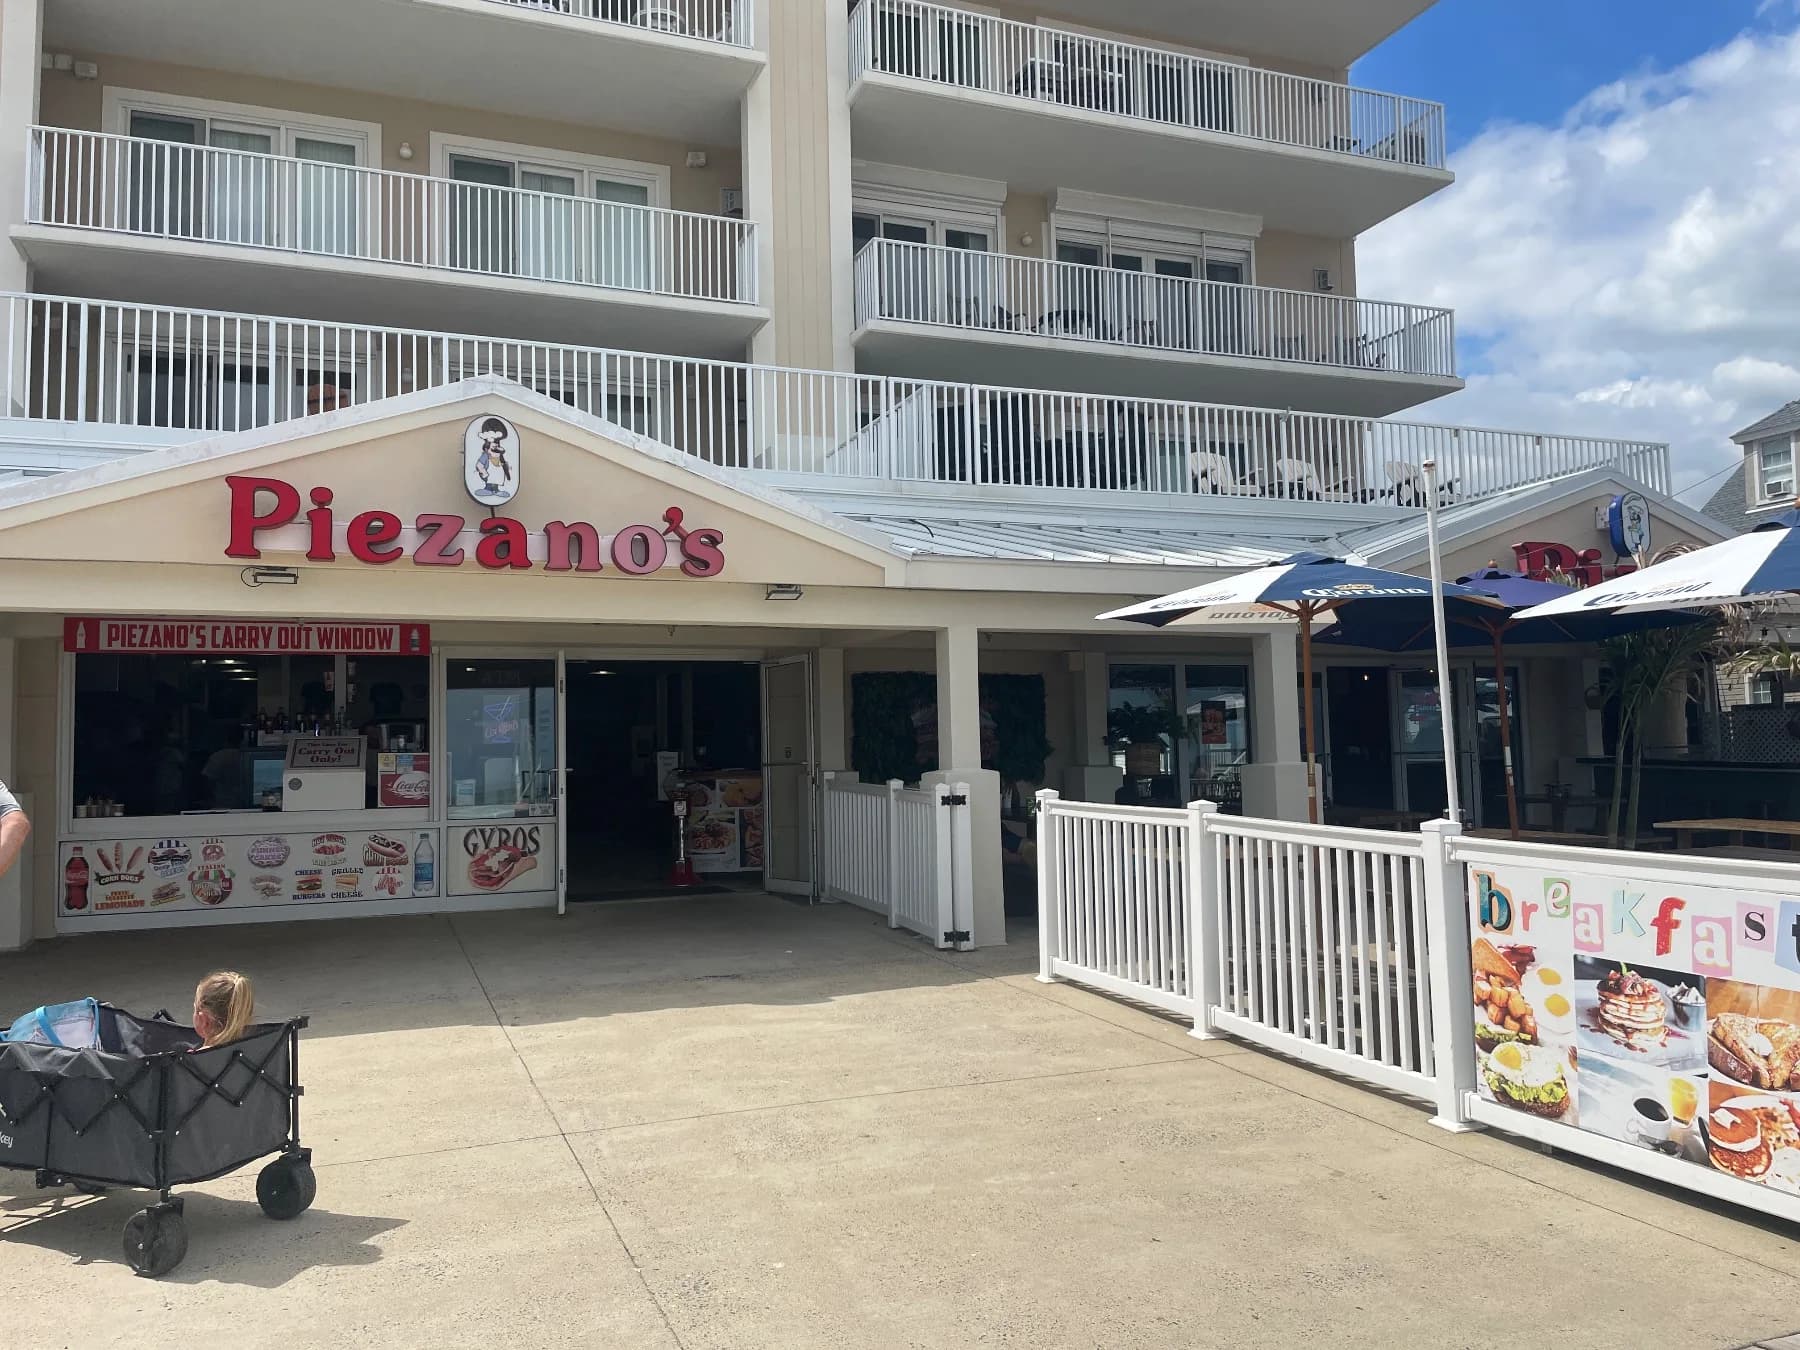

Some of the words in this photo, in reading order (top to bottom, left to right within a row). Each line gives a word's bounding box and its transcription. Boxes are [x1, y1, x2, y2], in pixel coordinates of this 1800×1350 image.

[224, 475, 725, 577] Piezano's
[1301, 587, 1429, 598] Corona
[107, 623, 206, 649] PIEZANO'S
[211, 624, 272, 649] CARRY
[278, 626, 313, 649] OUT
[316, 626, 394, 650] WINDOW
[298, 747, 331, 756] Carry
[335, 746, 355, 755] Out
[310, 755, 342, 763] Only!
[463, 825, 541, 857] GYROS
[331, 867, 364, 875] GRILLED
[100, 875, 119, 884] CORN
[292, 892, 326, 900] BURGERS
[331, 891, 364, 899] CHEESE
